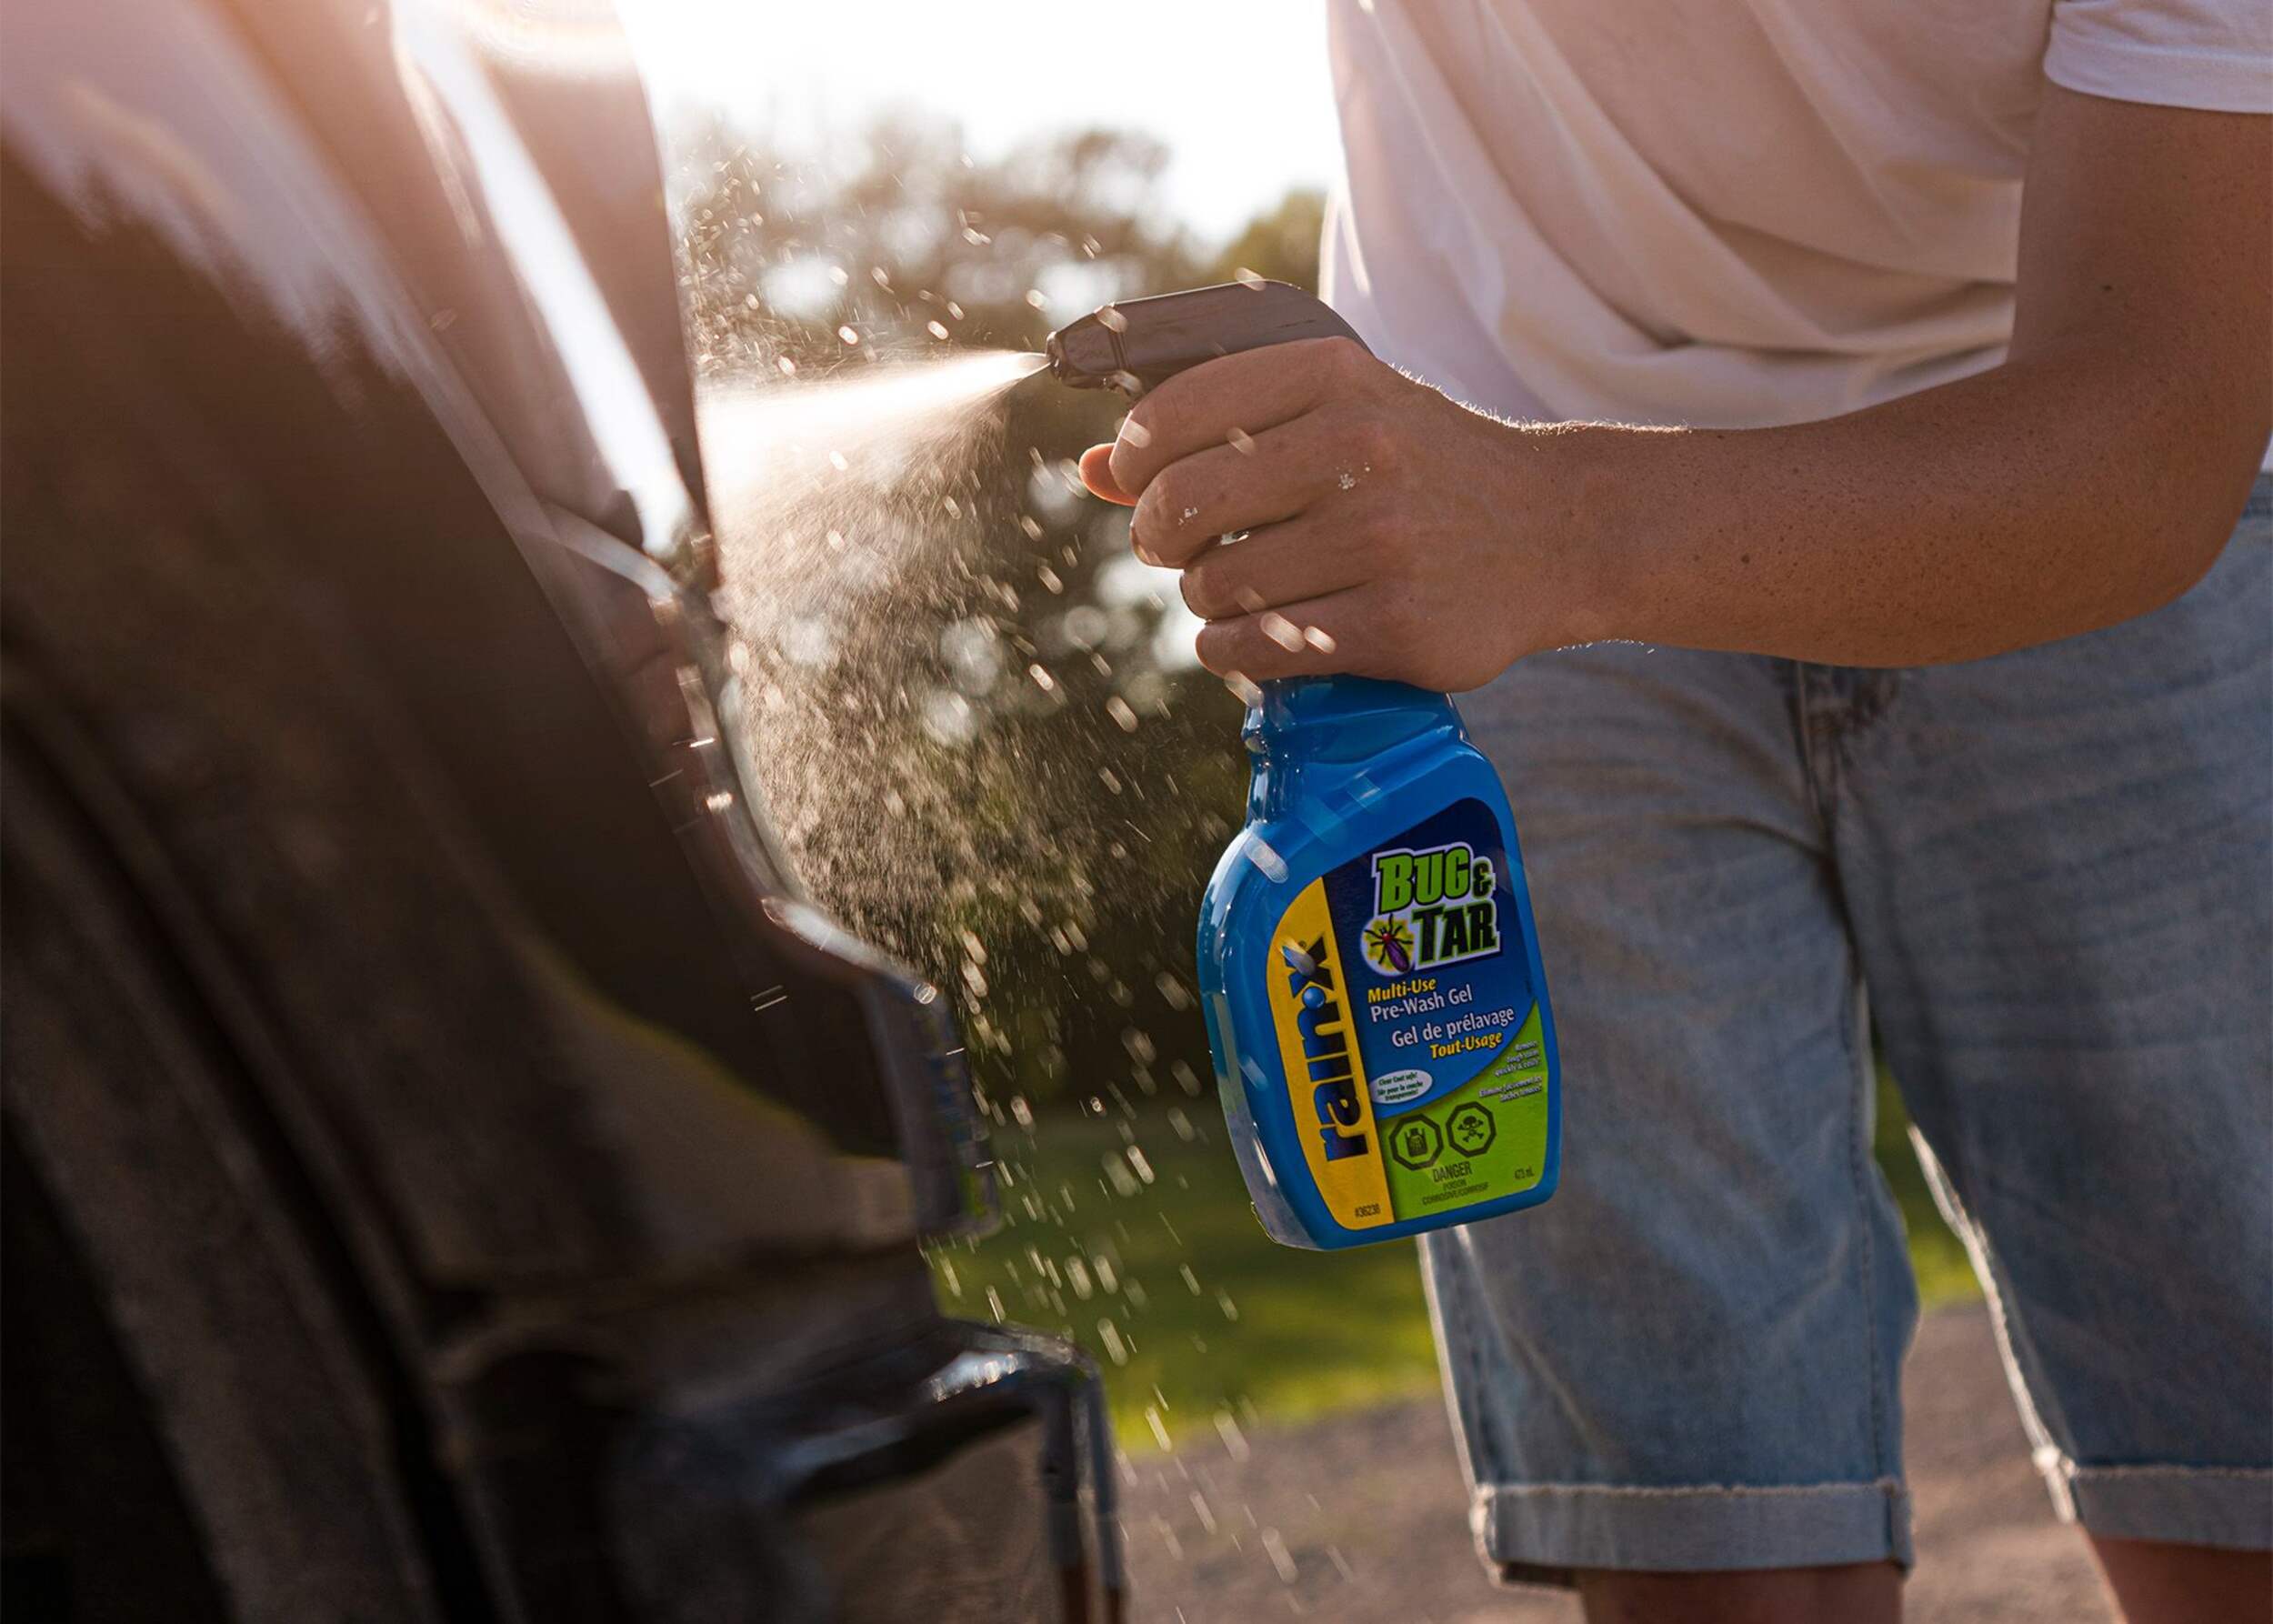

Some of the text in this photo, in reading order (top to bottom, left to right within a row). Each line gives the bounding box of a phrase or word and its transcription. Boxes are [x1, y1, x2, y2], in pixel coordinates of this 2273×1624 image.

[1377, 846, 1494, 915] BUG &
[1412, 902, 1499, 966] TAR
[1367, 977, 1437, 1004] Multi-Use
[1370, 984, 1473, 1023] Pre-Wash Gel
[1392, 1007, 1516, 1048] Gel de prélavage
[1429, 1032, 1503, 1059] Tout-Usage
[1433, 1160, 1472, 1183] DANGER
